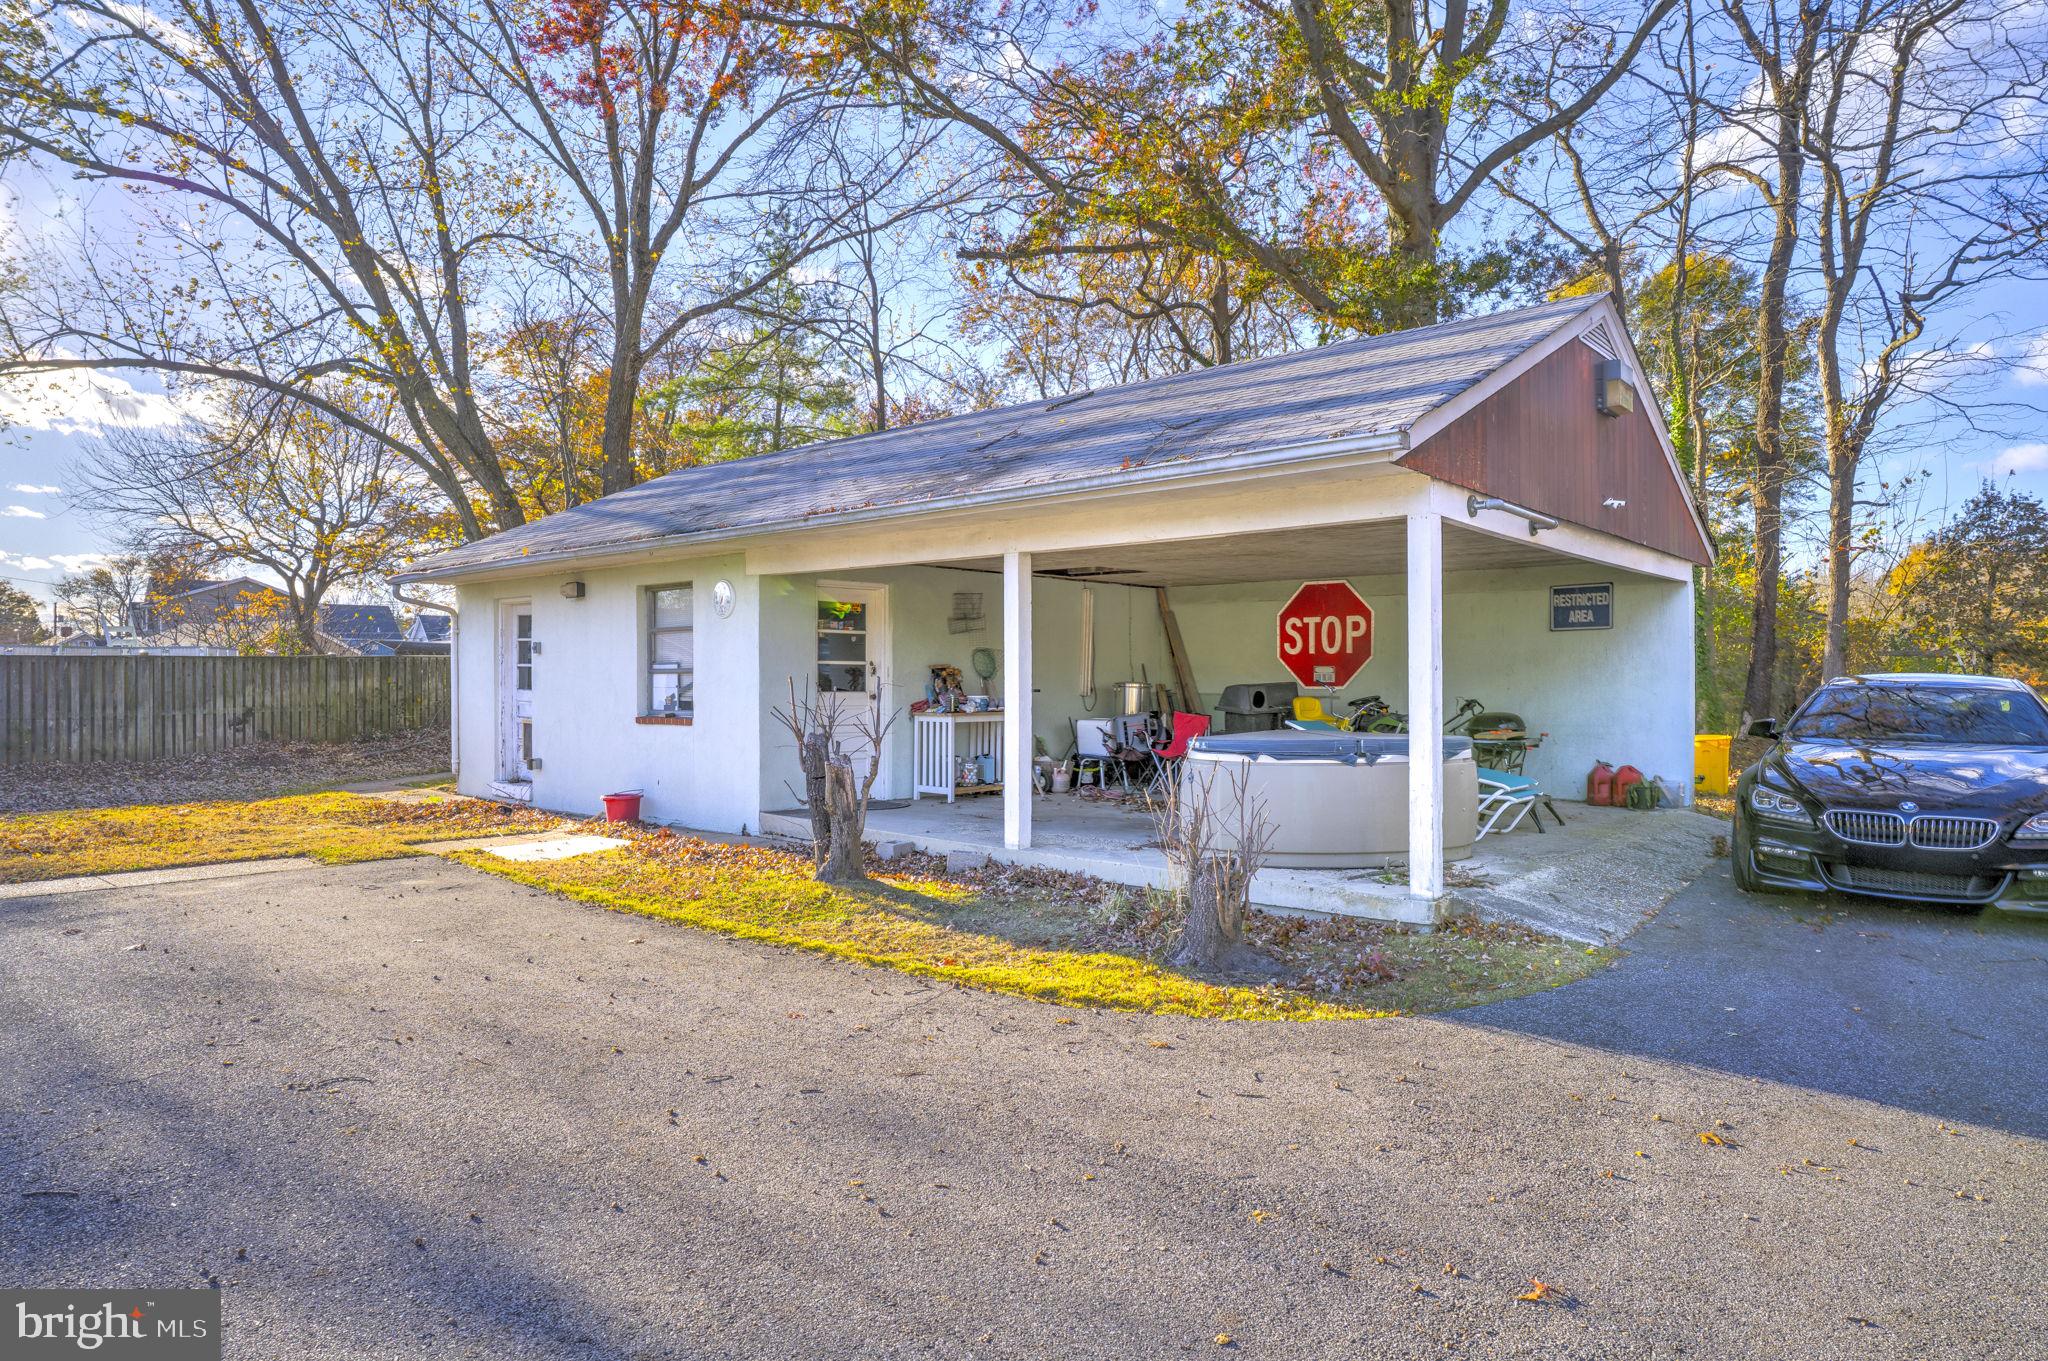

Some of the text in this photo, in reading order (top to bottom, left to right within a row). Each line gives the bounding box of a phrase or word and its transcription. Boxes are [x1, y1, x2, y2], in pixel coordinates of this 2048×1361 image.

[1553, 592, 1609, 607] RESTRICTED
[1568, 609, 1594, 623] AREA
[1283, 615, 1367, 655] STOP
